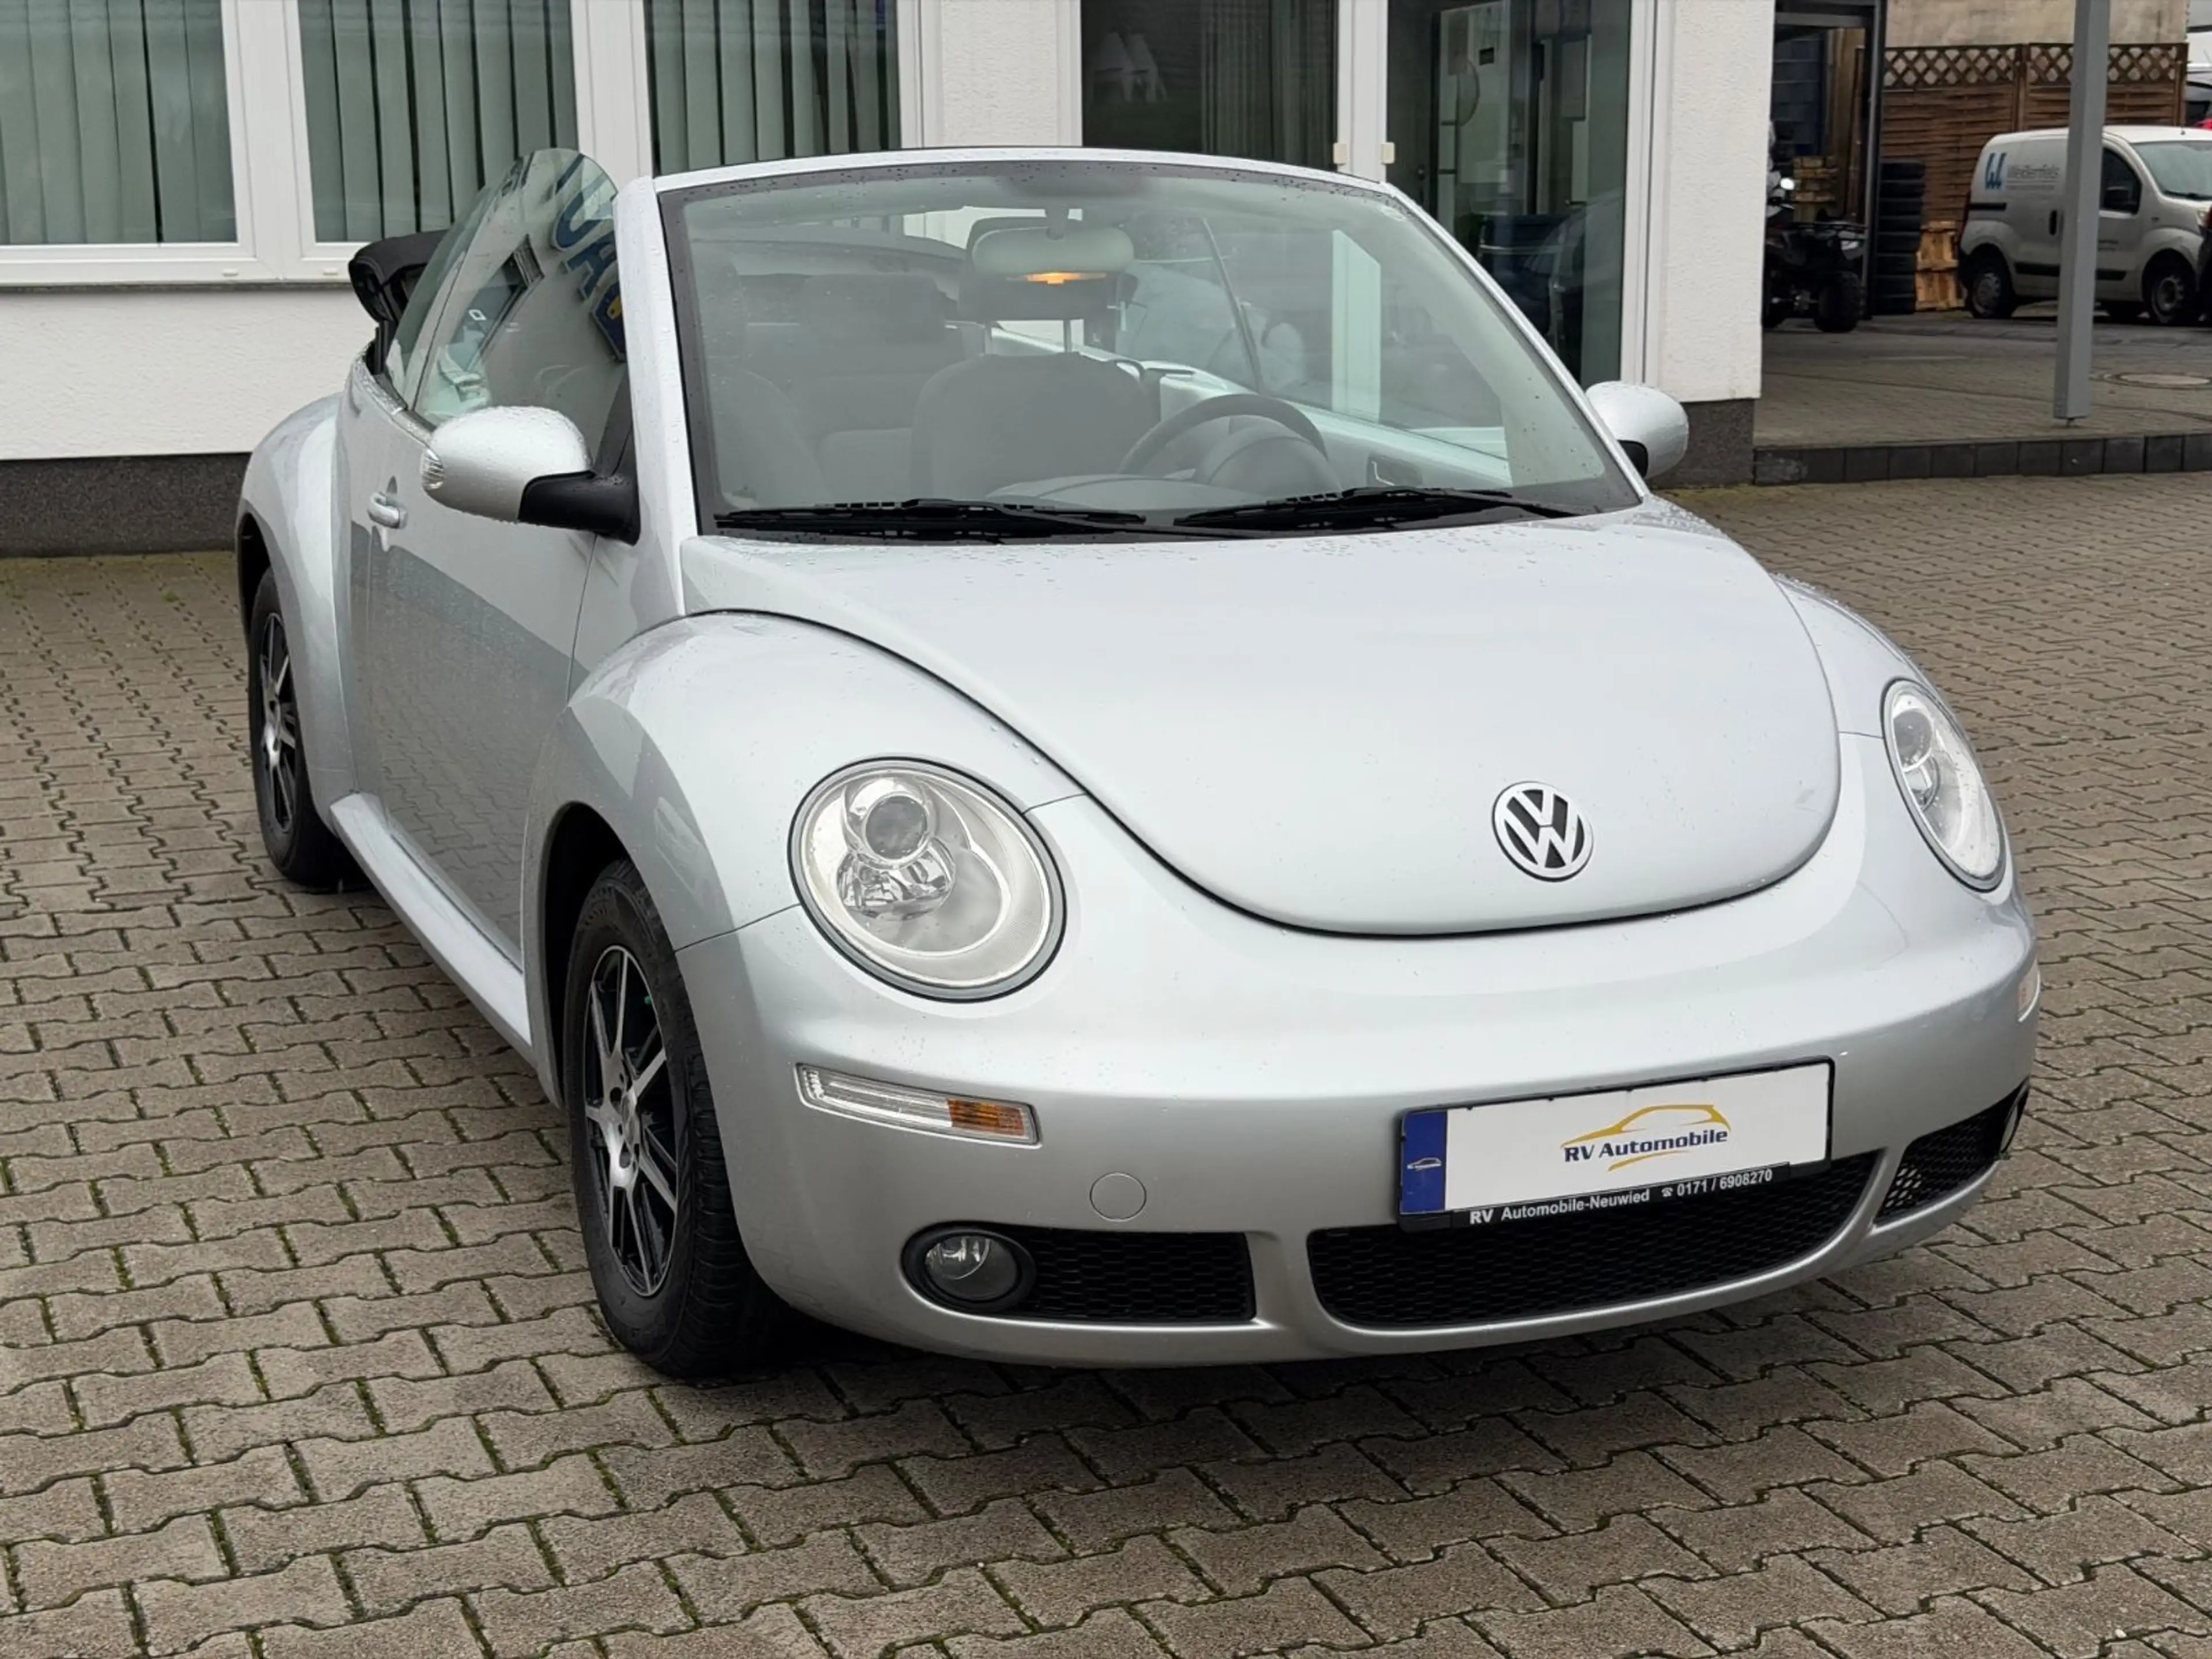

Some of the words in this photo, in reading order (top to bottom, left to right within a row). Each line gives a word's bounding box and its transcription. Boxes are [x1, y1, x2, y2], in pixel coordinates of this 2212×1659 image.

[1565, 1145, 1594, 1162] RV
[1599, 1129, 1728, 1158] Automobile
[1469, 1209, 1494, 1225] RV
[1501, 1188, 1650, 1221] Automobile-Neuwied
[1676, 1181, 1707, 1197] 0171
[1719, 1169, 1773, 1190] 6908270
